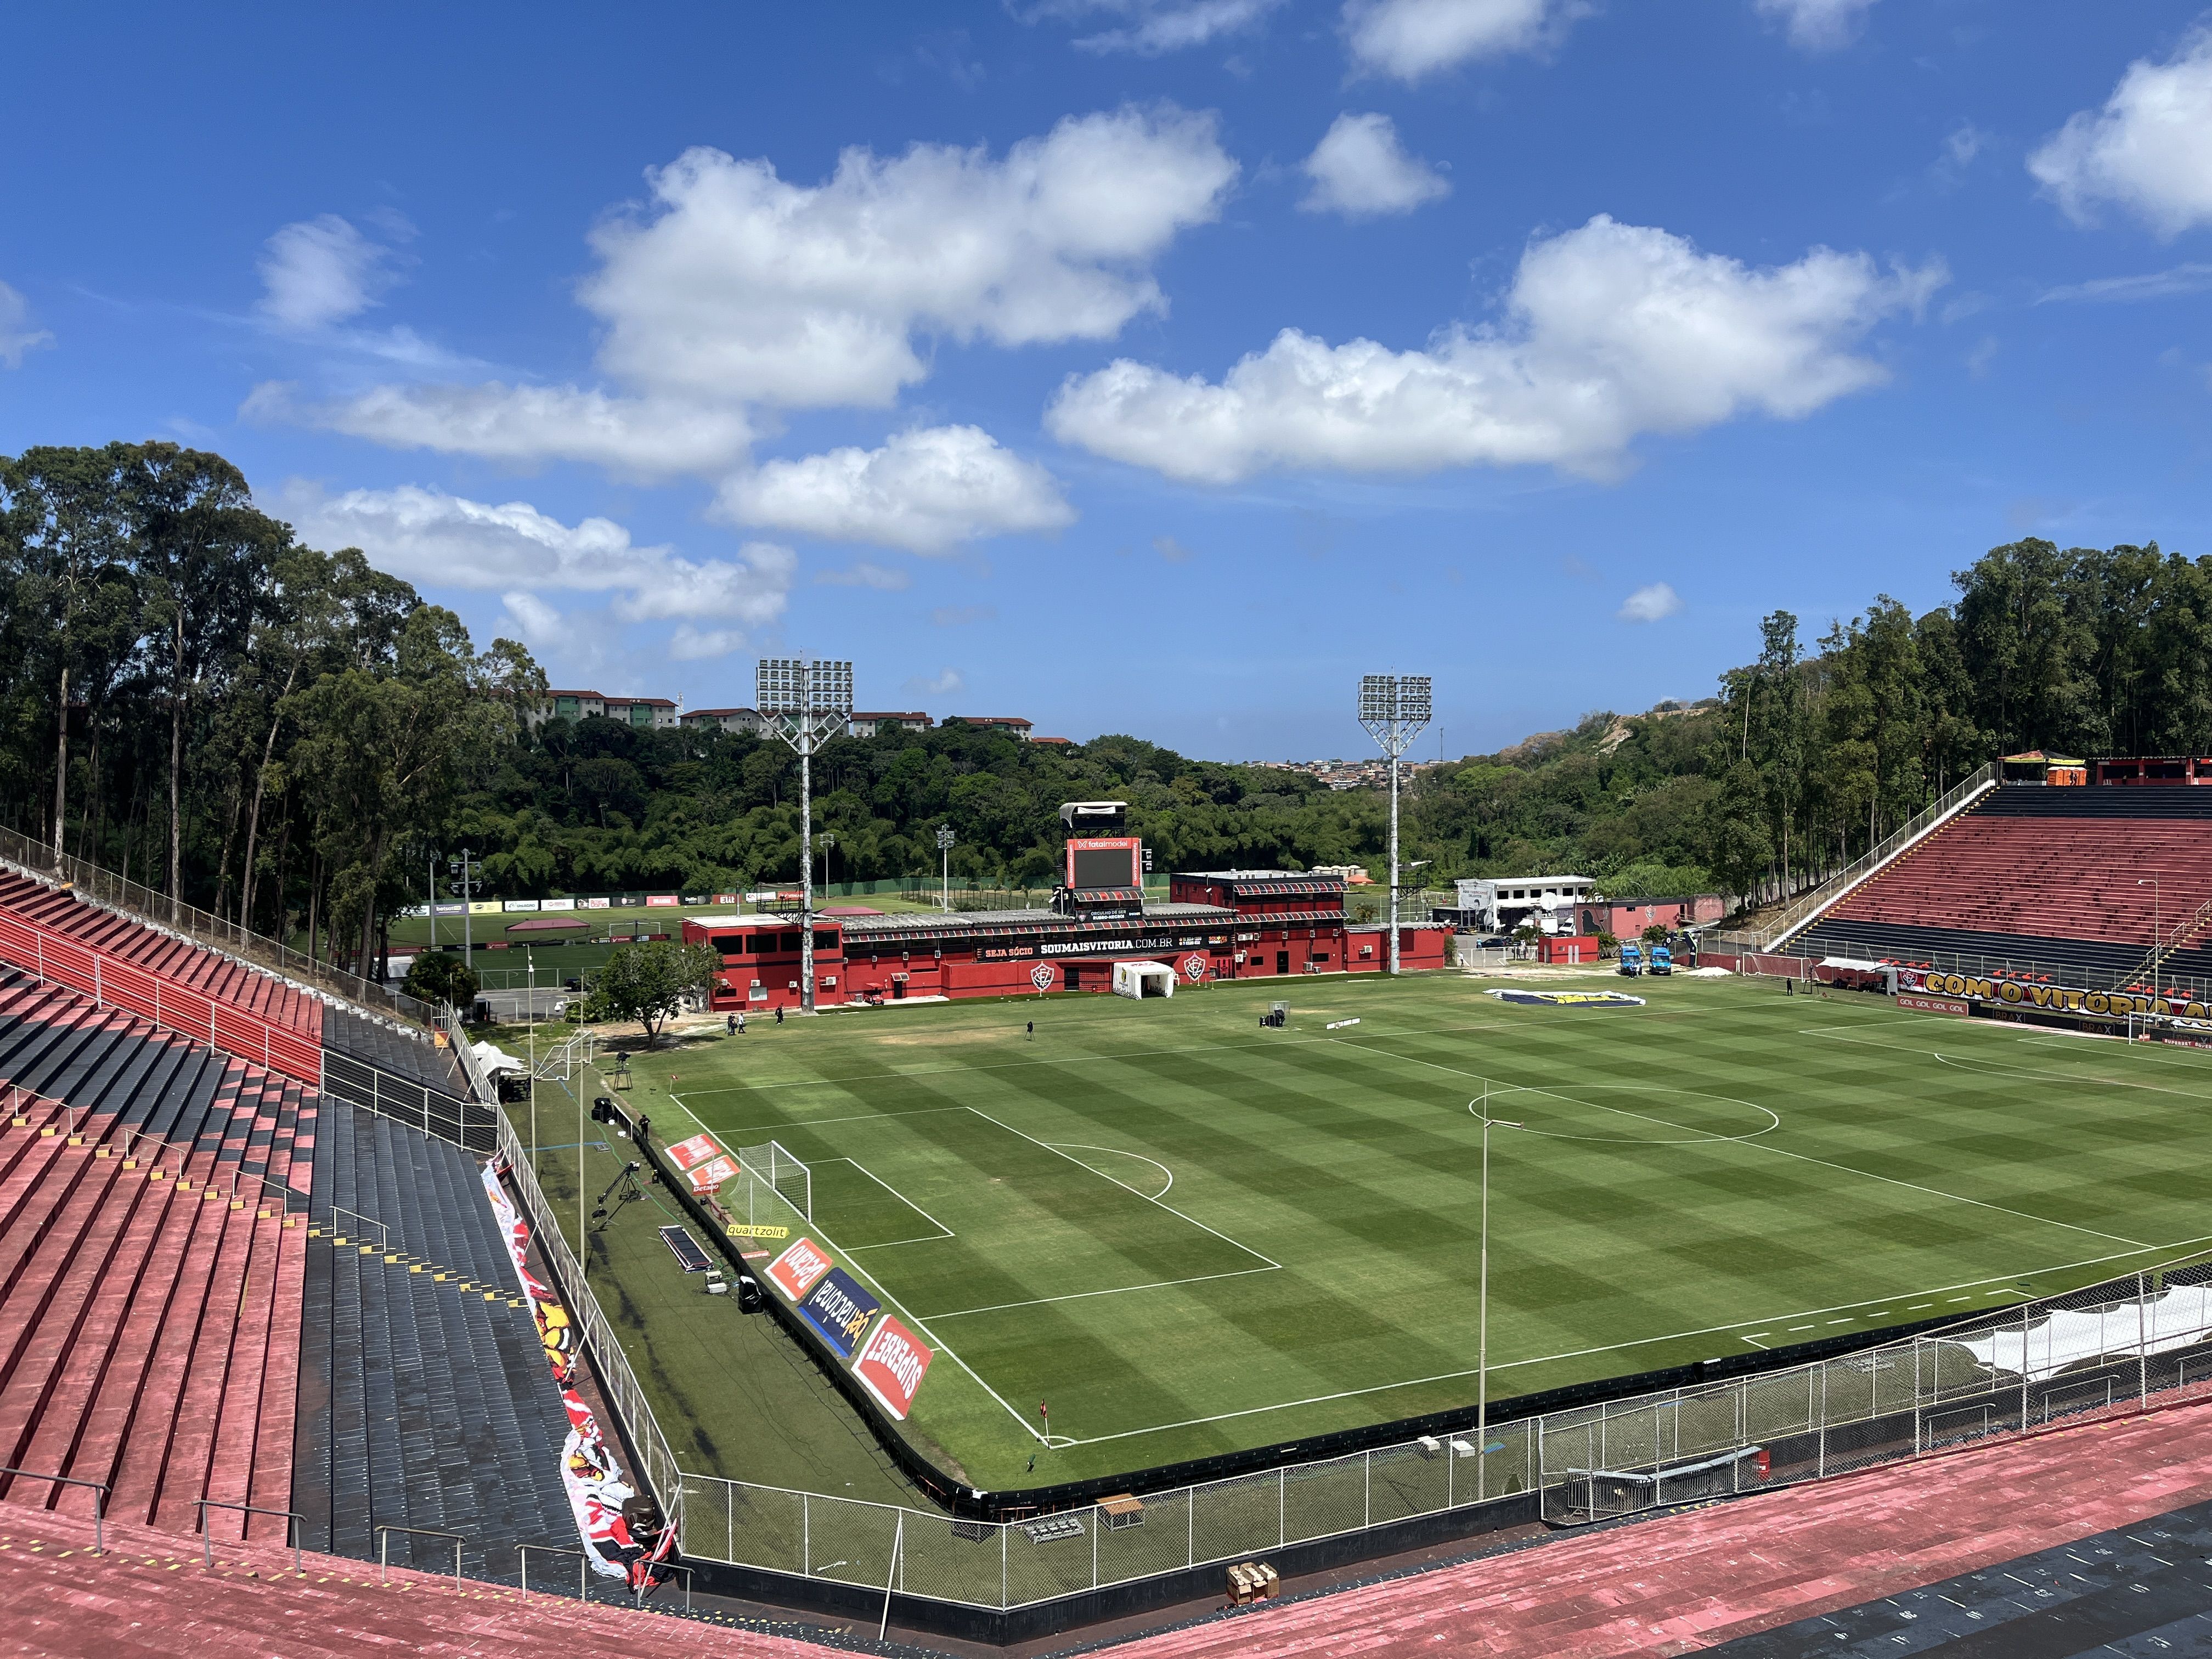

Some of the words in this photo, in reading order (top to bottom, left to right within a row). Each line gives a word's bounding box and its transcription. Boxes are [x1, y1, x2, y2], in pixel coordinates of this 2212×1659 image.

[985, 949, 1008, 957] SEJA
[1009, 946, 1033, 956] SÓCIO
[1041, 938, 1173, 954] SOUMAISVITORIA.COM.BR
[1925, 972, 1994, 1000] COM
[1999, 981, 2023, 1003] O
[2028, 985, 2174, 1020] VITÓRIA
[1900, 998, 1914, 1006] GOL
[1916, 1000, 1931, 1008] GOL
[1933, 1002, 1947, 1011] GOL
[1949, 1005, 1965, 1013] GOL
[1995, 1011, 2022, 1023] BRAX
[2082, 1022, 2112, 1035] BRAX
[729, 1226, 785, 1237] quartzolit
[785, 1245, 827, 1289] Betano
[808, 1279, 870, 1348] betnacional
[866, 1330, 923, 1400] SUPERBET
